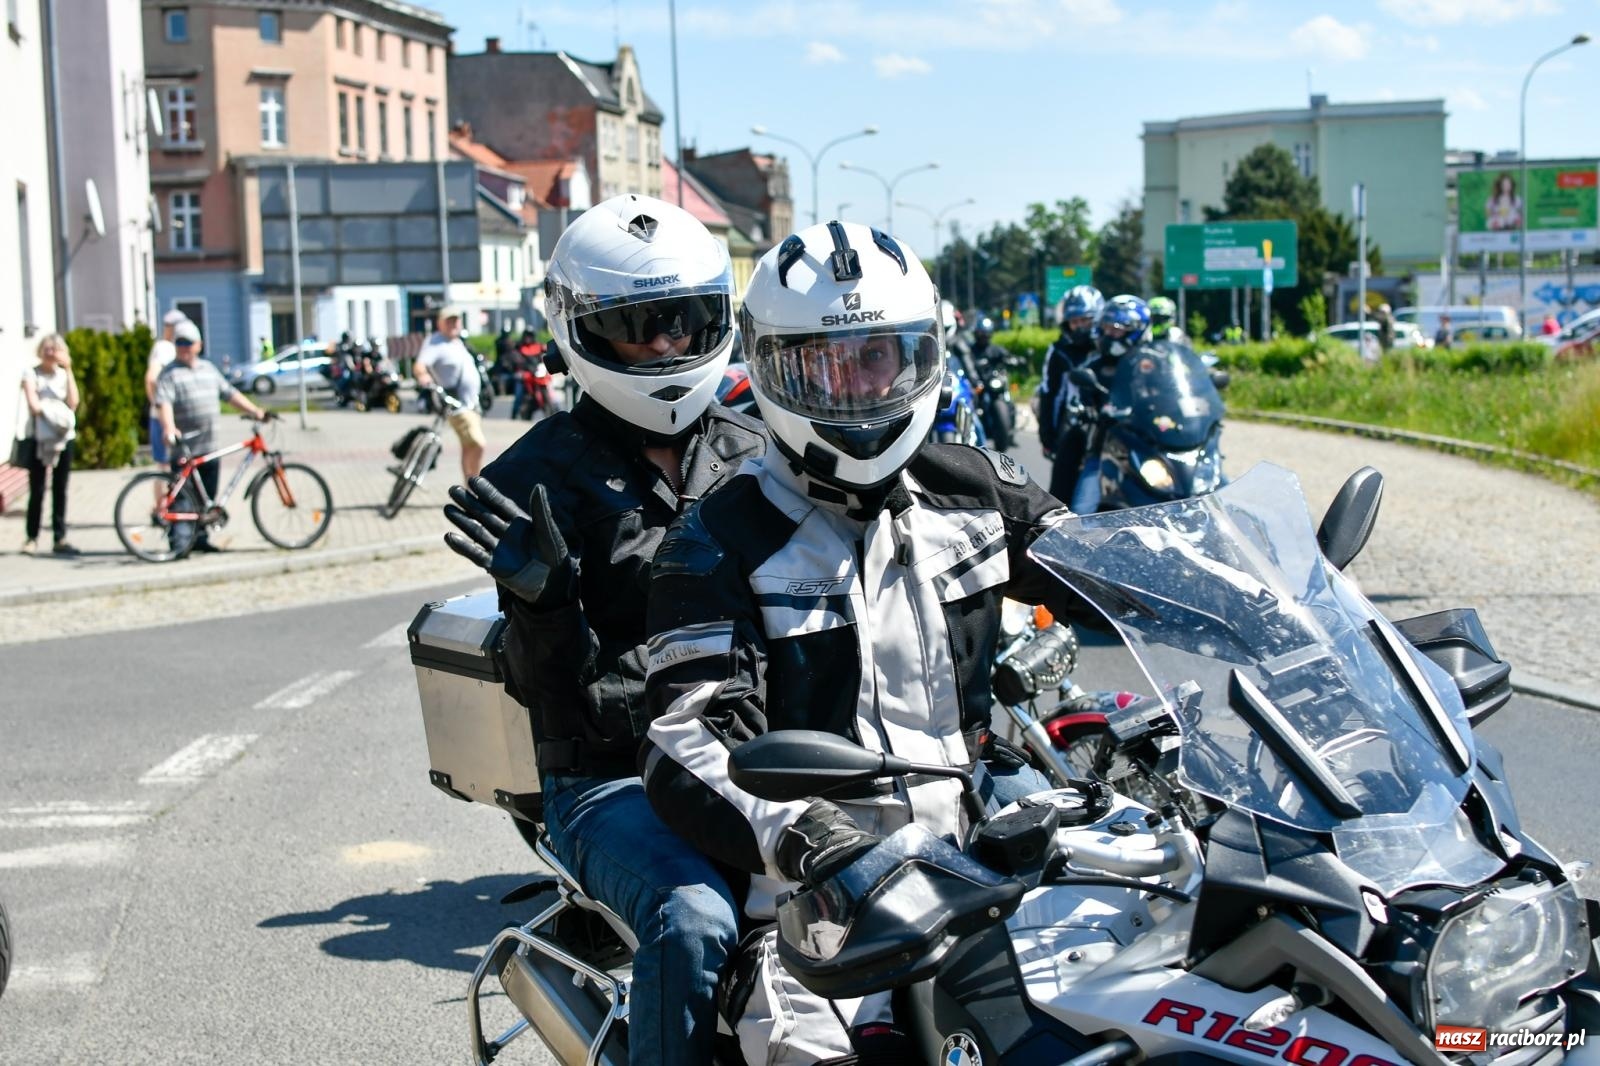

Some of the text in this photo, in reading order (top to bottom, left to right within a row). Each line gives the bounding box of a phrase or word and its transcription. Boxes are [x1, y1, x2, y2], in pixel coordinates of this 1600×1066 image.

[633, 274, 680, 289] SHARK
[821, 310, 886, 326] SHARK
[786, 579, 845, 595] RST
